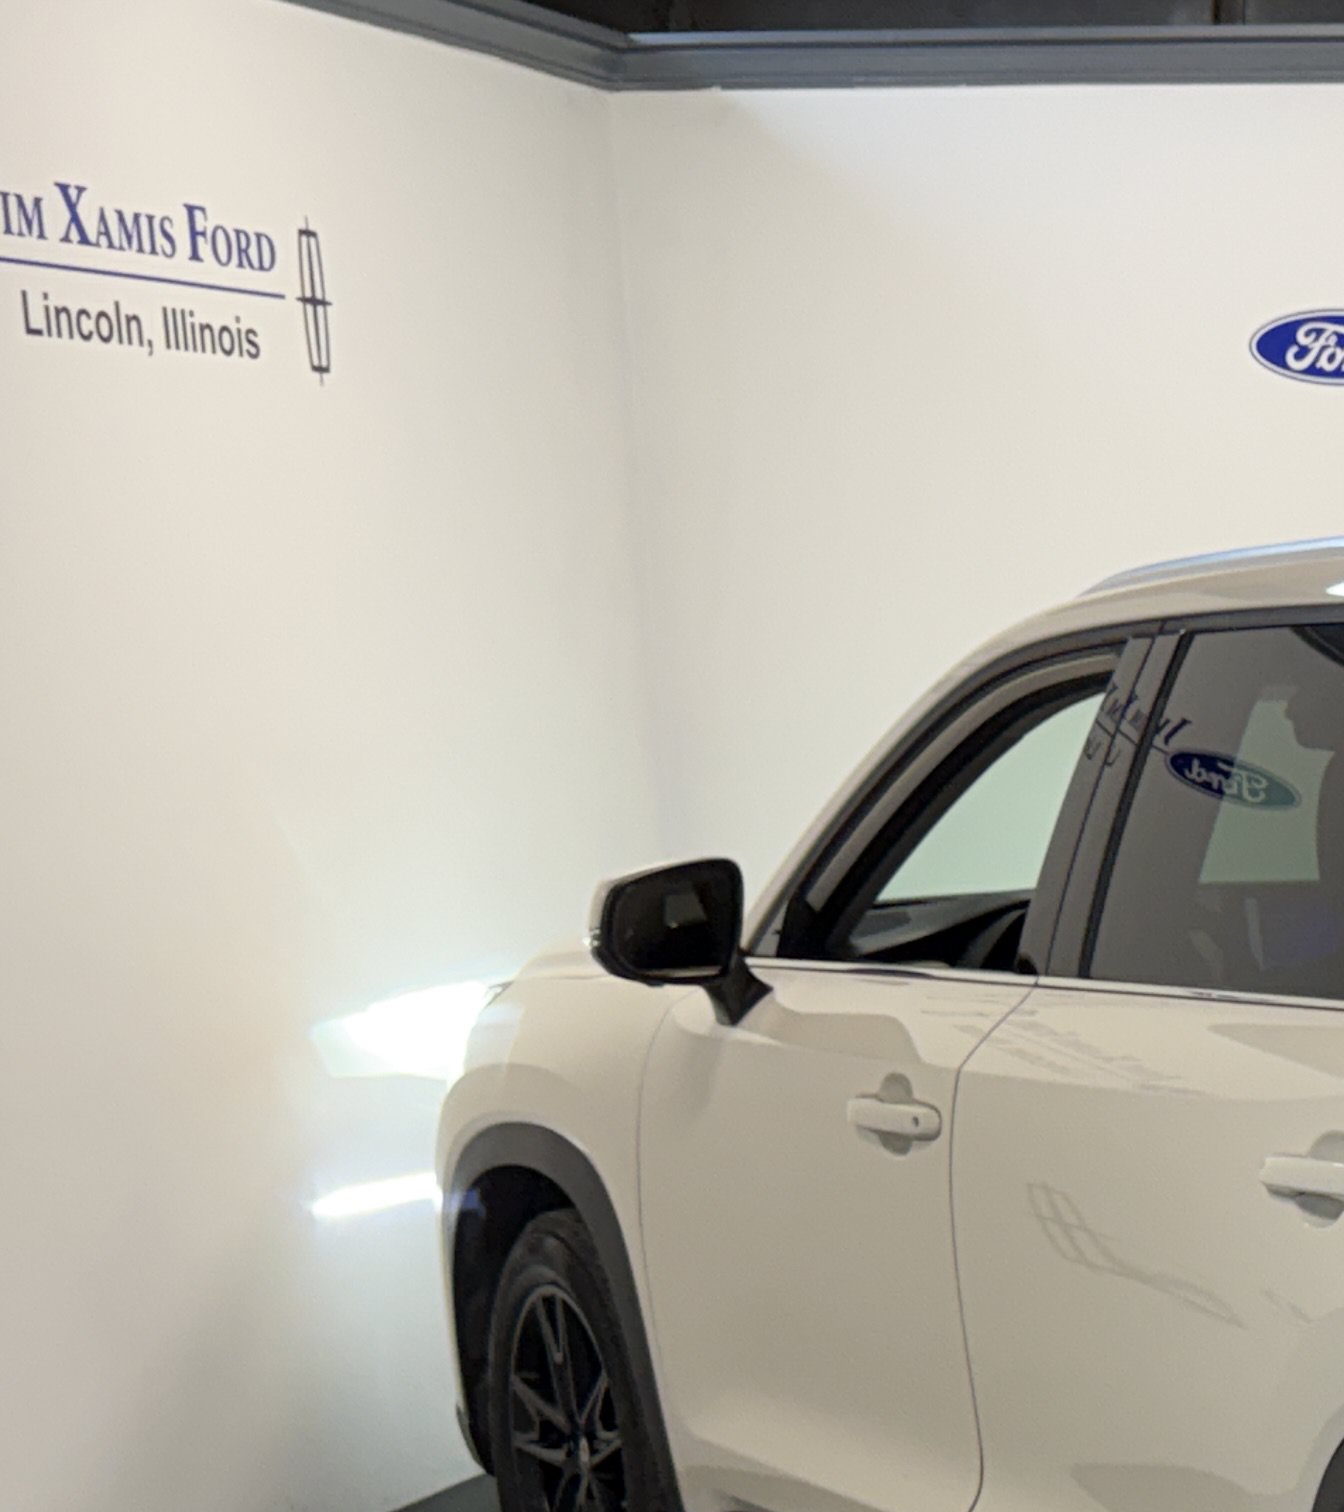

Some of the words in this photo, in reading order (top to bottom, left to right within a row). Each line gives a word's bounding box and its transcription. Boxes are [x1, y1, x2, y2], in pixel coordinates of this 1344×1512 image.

[0, 191, 48, 240] IM
[54, 181, 178, 259] XAMIS
[182, 203, 277, 272] FORD
[20, 289, 155, 357] Lincoln,
[161, 305, 261, 360] Illinois
